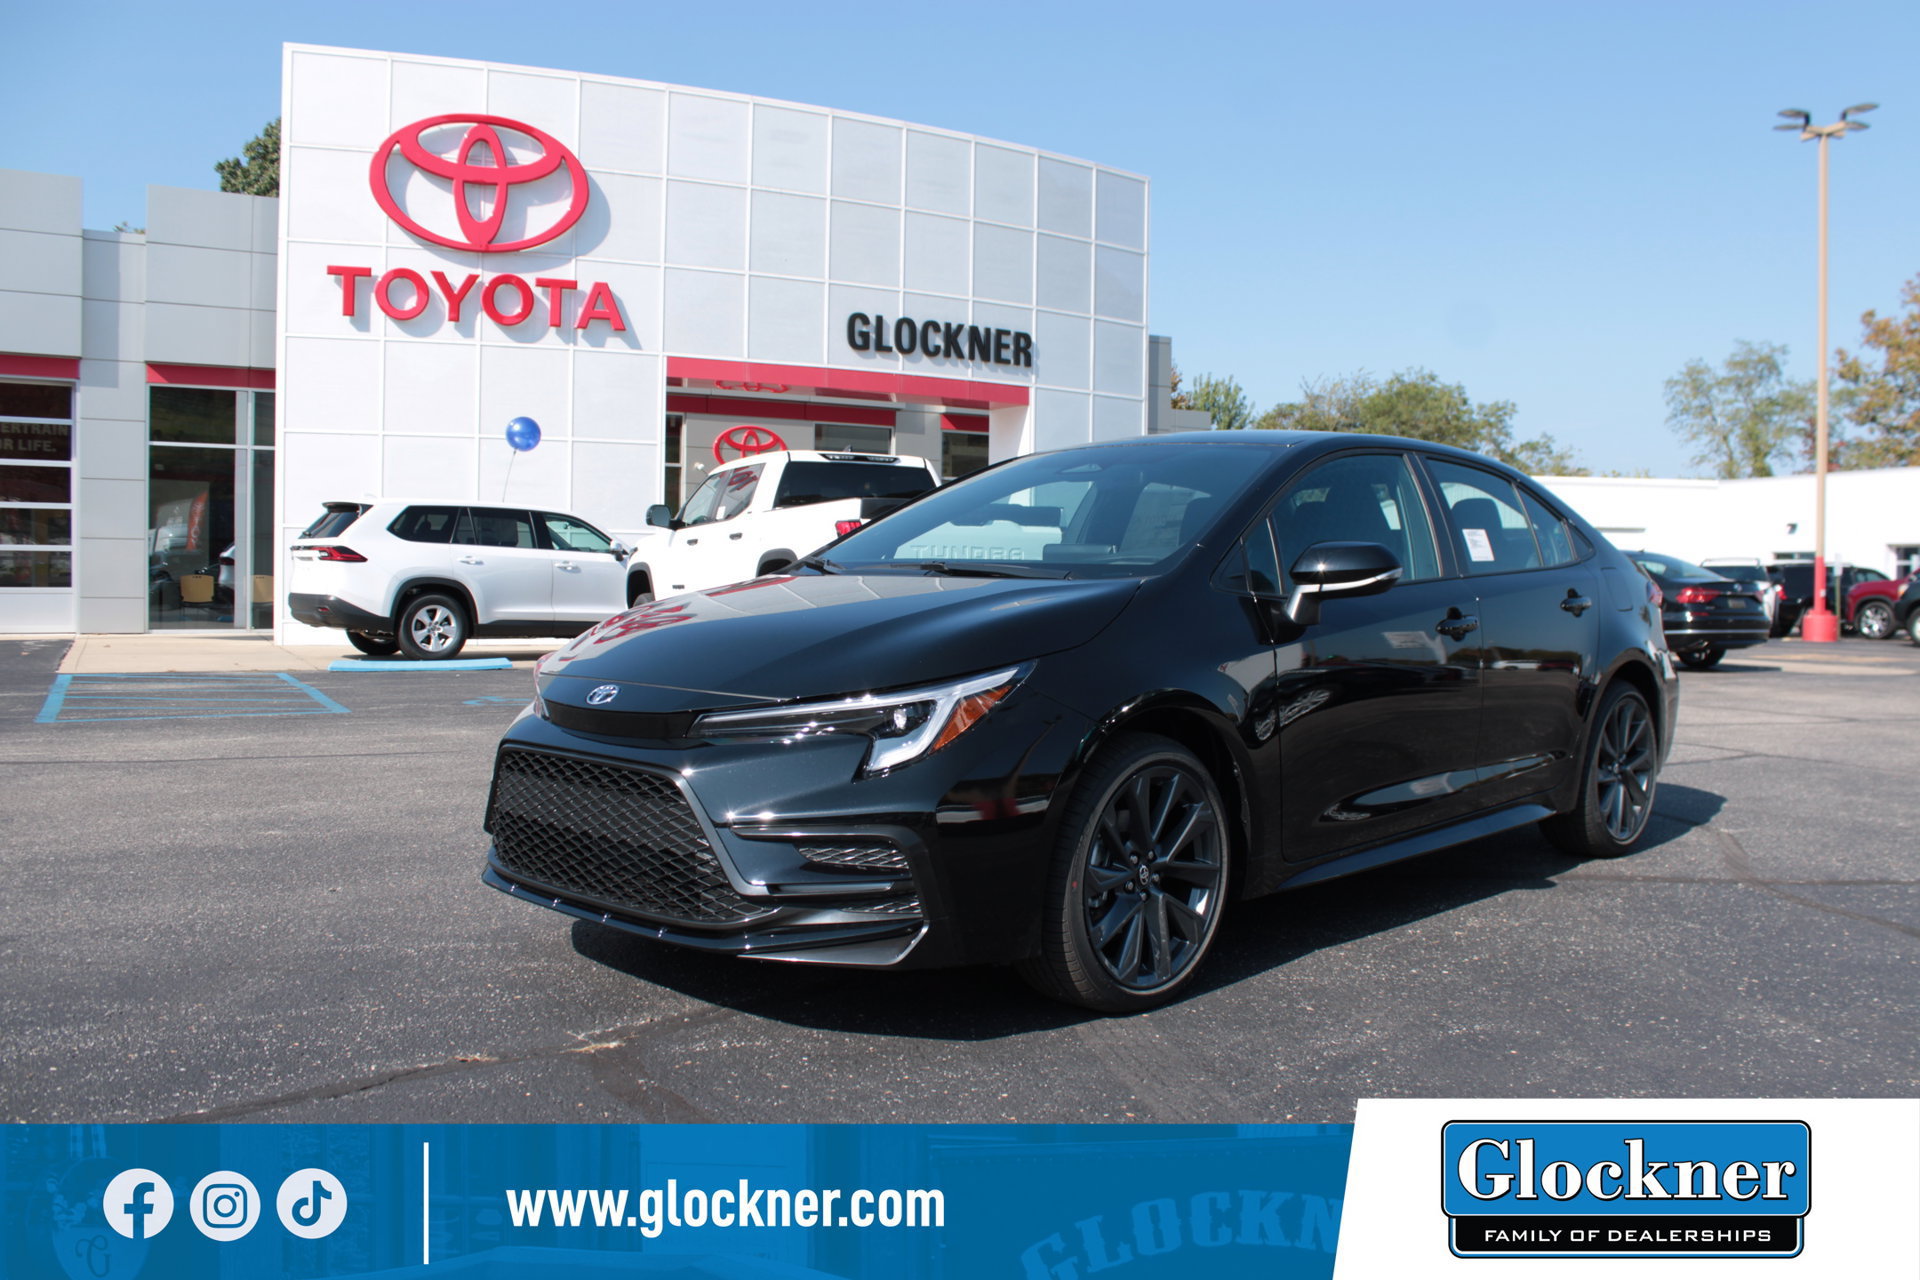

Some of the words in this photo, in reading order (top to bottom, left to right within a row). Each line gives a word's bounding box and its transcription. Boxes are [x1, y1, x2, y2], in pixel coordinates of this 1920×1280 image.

[327, 265, 626, 332] TOYOTA
[847, 312, 1032, 368] GLOCKNER
[910, 545, 1025, 560] TUNDRA
